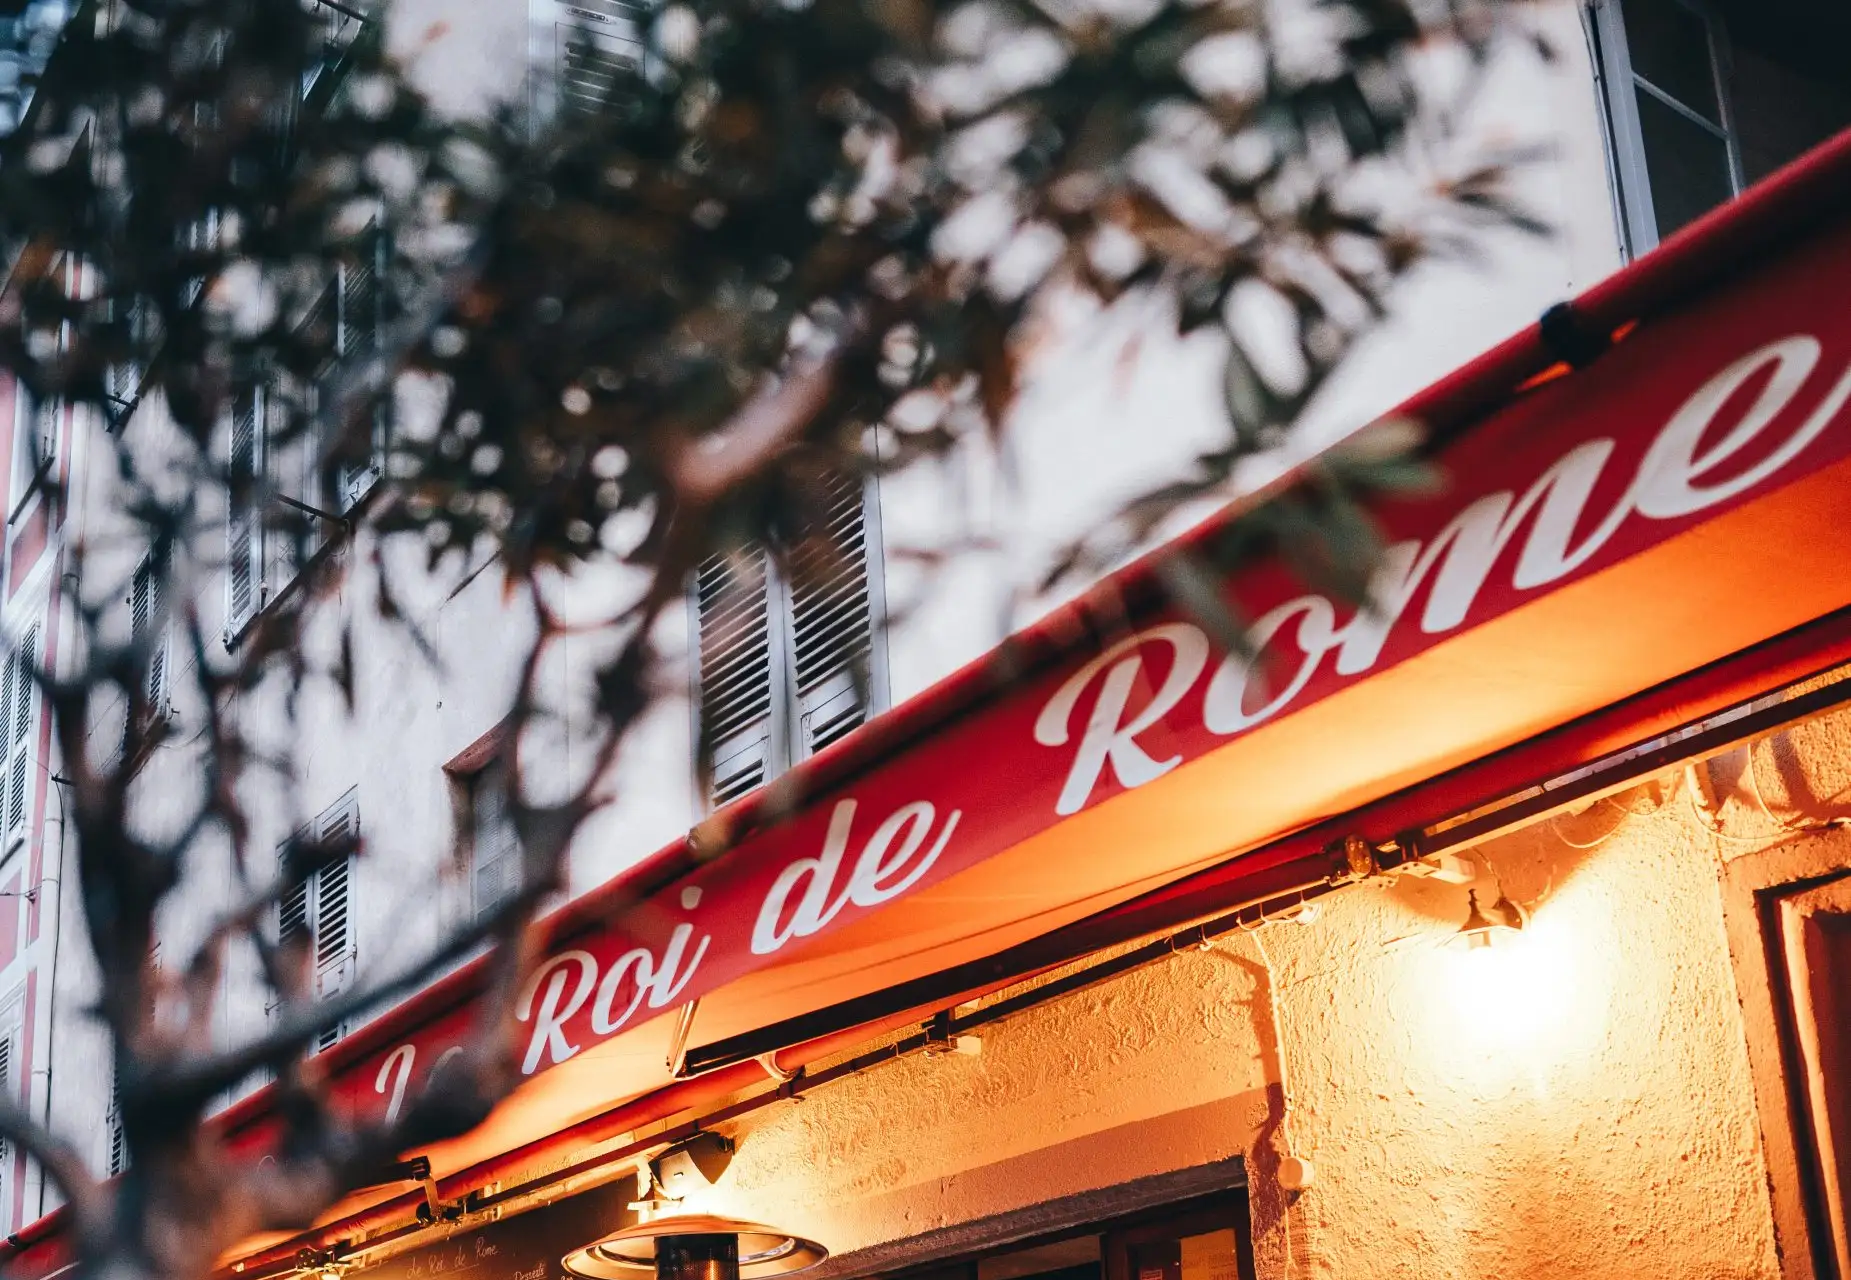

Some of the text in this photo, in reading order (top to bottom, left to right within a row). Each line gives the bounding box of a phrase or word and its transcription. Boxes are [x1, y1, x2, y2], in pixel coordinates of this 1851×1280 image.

[516, 885, 711, 1075] Roi
[751, 798, 962, 956] de
[1034, 334, 1851, 816] Rome
